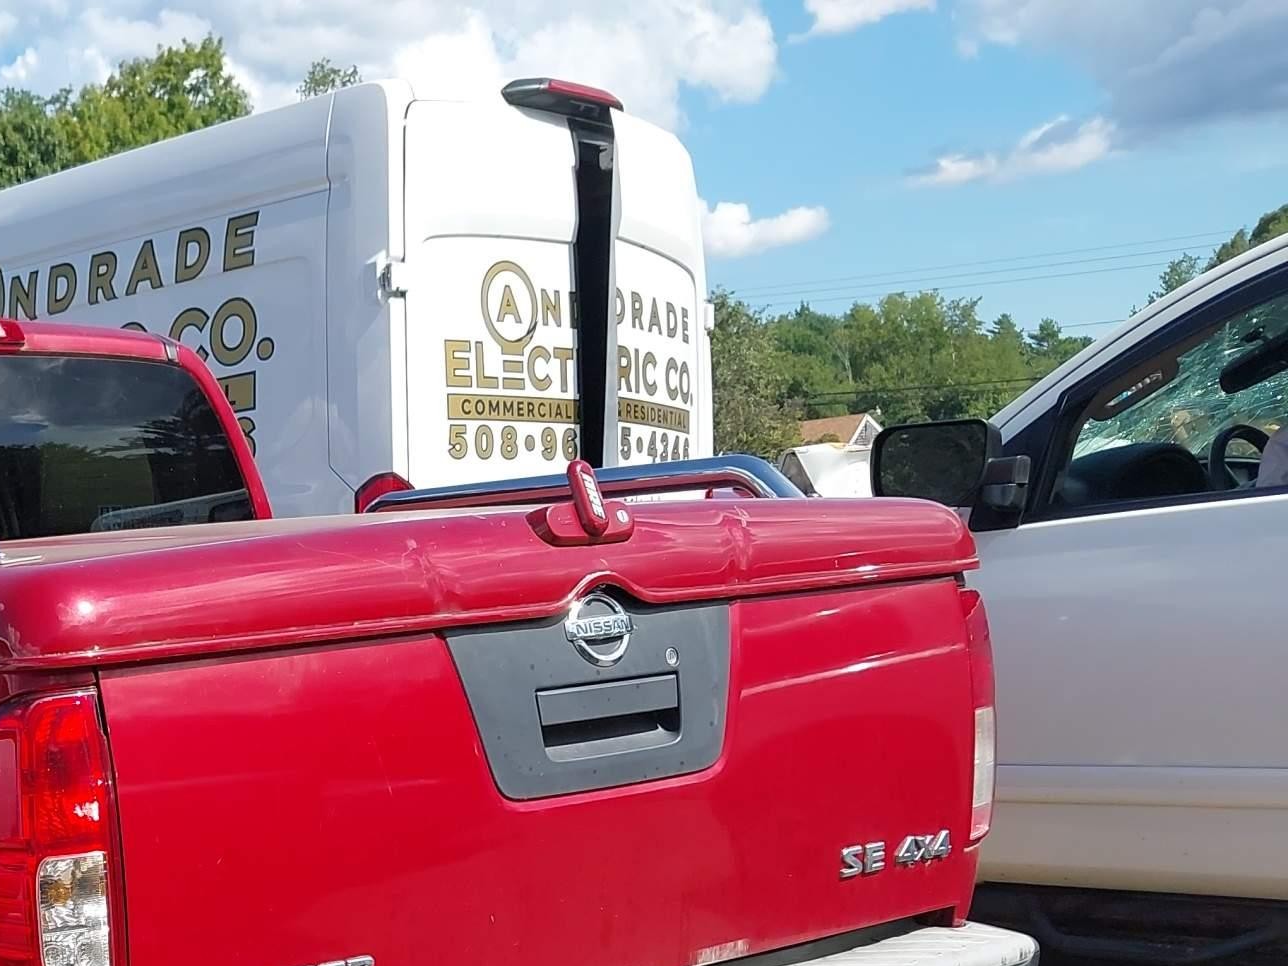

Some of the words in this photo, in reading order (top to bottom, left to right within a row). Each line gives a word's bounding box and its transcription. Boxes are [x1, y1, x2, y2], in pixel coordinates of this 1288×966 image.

[460, 398, 573, 421] COMMERCIAL
[625, 402, 687, 430] RESIDENTIAL
[575, 617, 631, 636] NISSAN
[839, 841, 885, 878] SE
